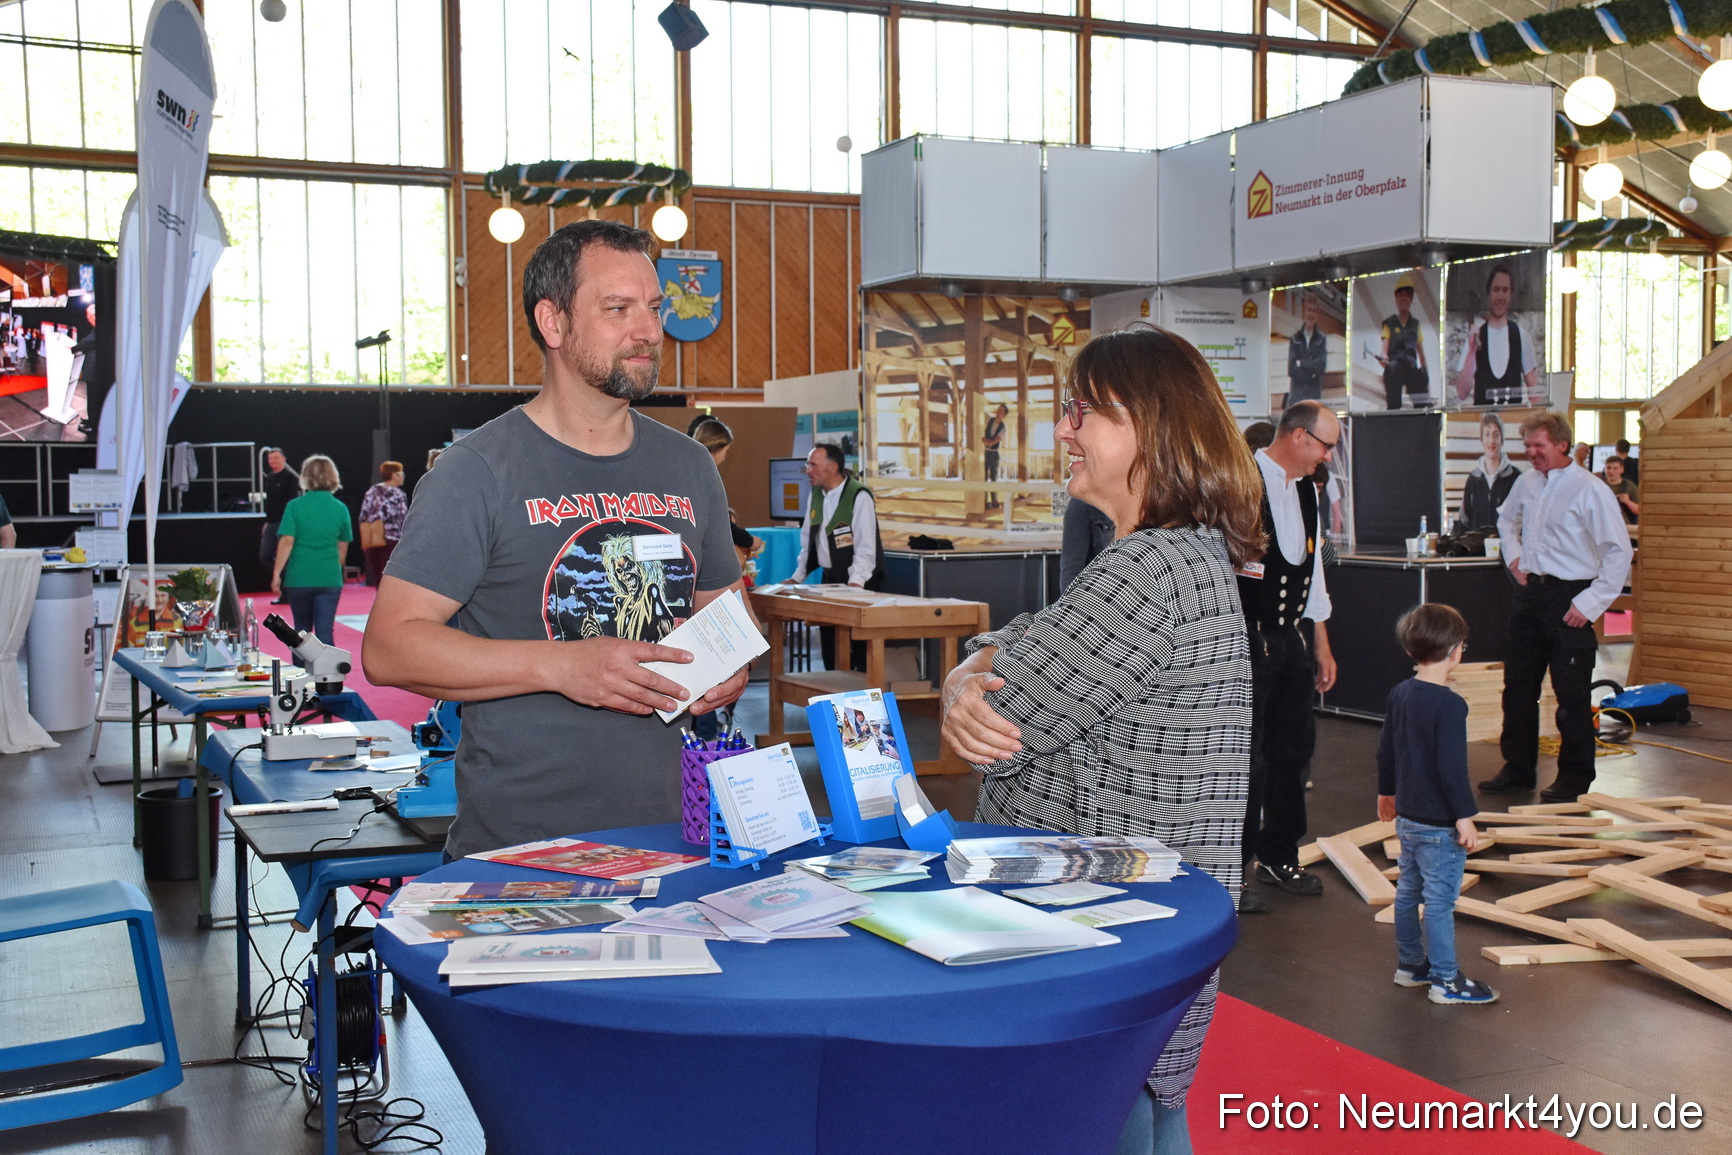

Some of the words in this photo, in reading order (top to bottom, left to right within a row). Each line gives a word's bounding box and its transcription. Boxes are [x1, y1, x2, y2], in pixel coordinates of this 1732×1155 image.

[156, 89, 187, 126] swn
[1275, 169, 1364, 197] Zimmerer-Innung
[1275, 194, 1321, 214] Neumarkt
[1324, 193, 1334, 204] in
[1336, 189, 1353, 202] der
[1355, 177, 1407, 198] Oberpfalz
[525, 493, 601, 527] IRON
[598, 492, 696, 528] MAIDEN
